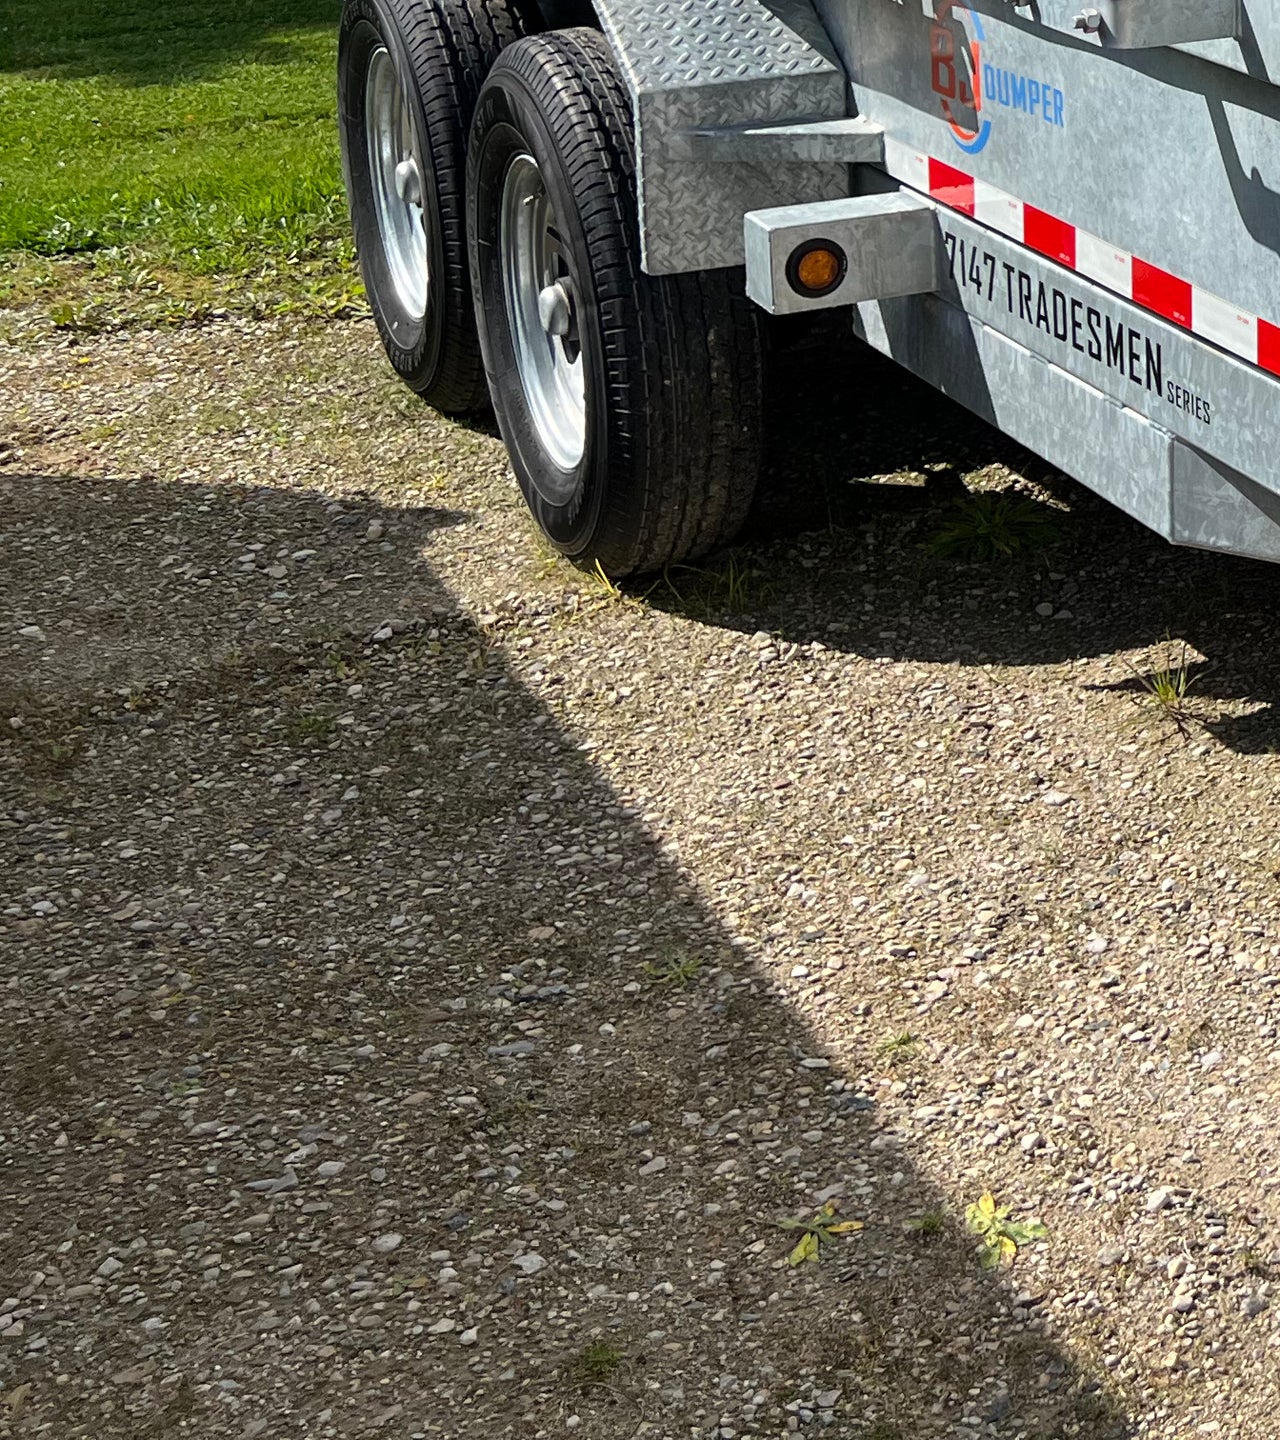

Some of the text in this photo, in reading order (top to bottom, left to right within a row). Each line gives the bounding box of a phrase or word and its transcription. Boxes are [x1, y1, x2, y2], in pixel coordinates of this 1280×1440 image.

[983, 63, 1064, 128] DUMPER
[944, 231, 1211, 425] 7147 TRADESMEN SERIES
